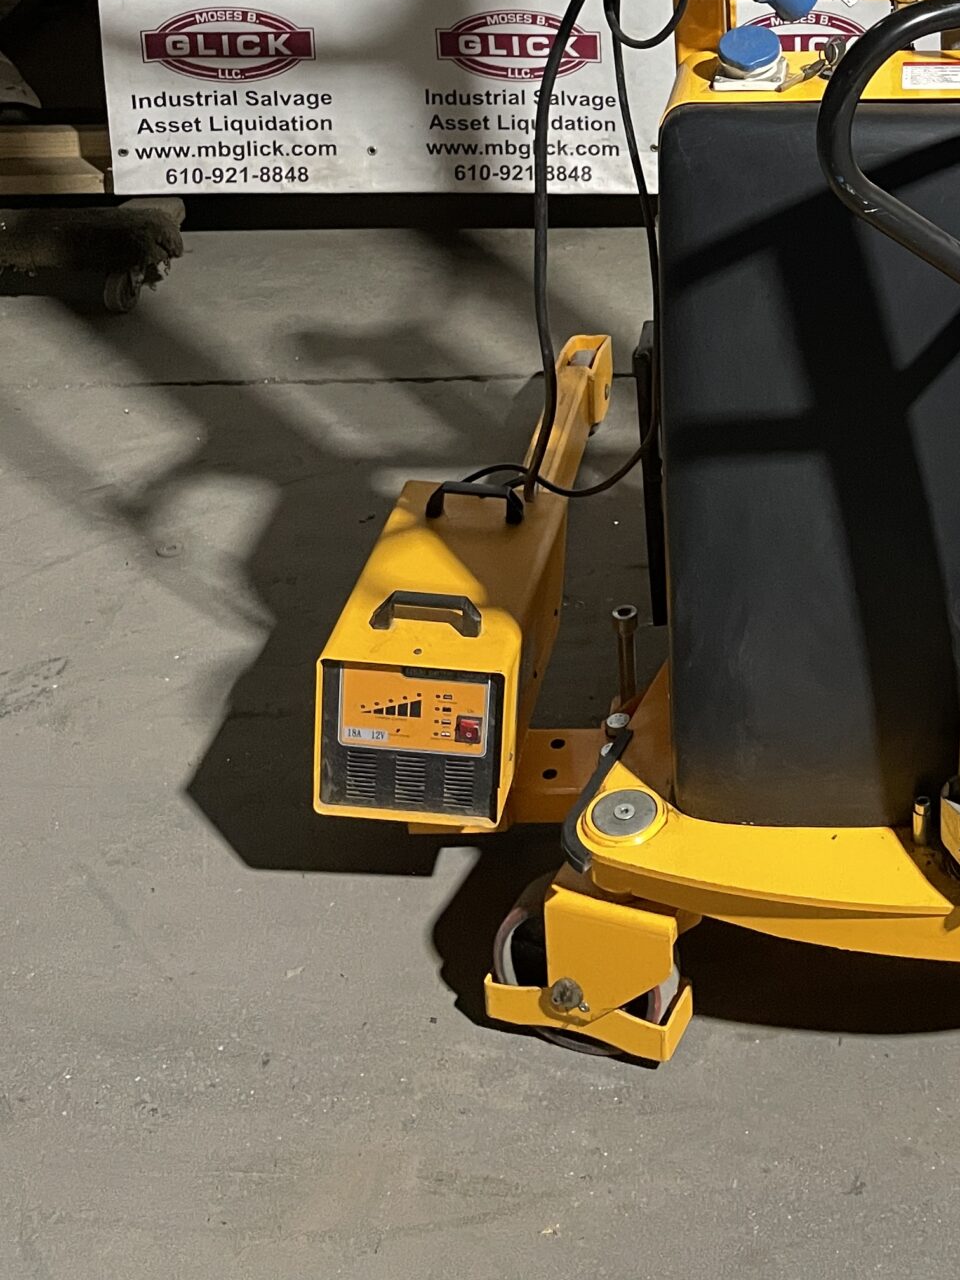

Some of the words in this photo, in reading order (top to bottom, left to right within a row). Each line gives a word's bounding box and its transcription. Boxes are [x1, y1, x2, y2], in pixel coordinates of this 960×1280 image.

[195, 11, 243, 24] MOSES
[487, 14, 532, 25] MOSES
[165, 34, 292, 56] GLICK
[218, 69, 245, 78] LLC.
[507, 69, 533, 78] LLC.
[132, 90, 237, 109] Industrial
[245, 91, 332, 109] Salvage
[137, 117, 202, 134] Asset
[210, 116, 332, 135] Liquidation
[135, 140, 336, 161] www.mbglick.com
[166, 166, 309, 184] 610-921-8848
[347, 728, 362, 738] 18A
[371, 730, 385, 740] 12V
